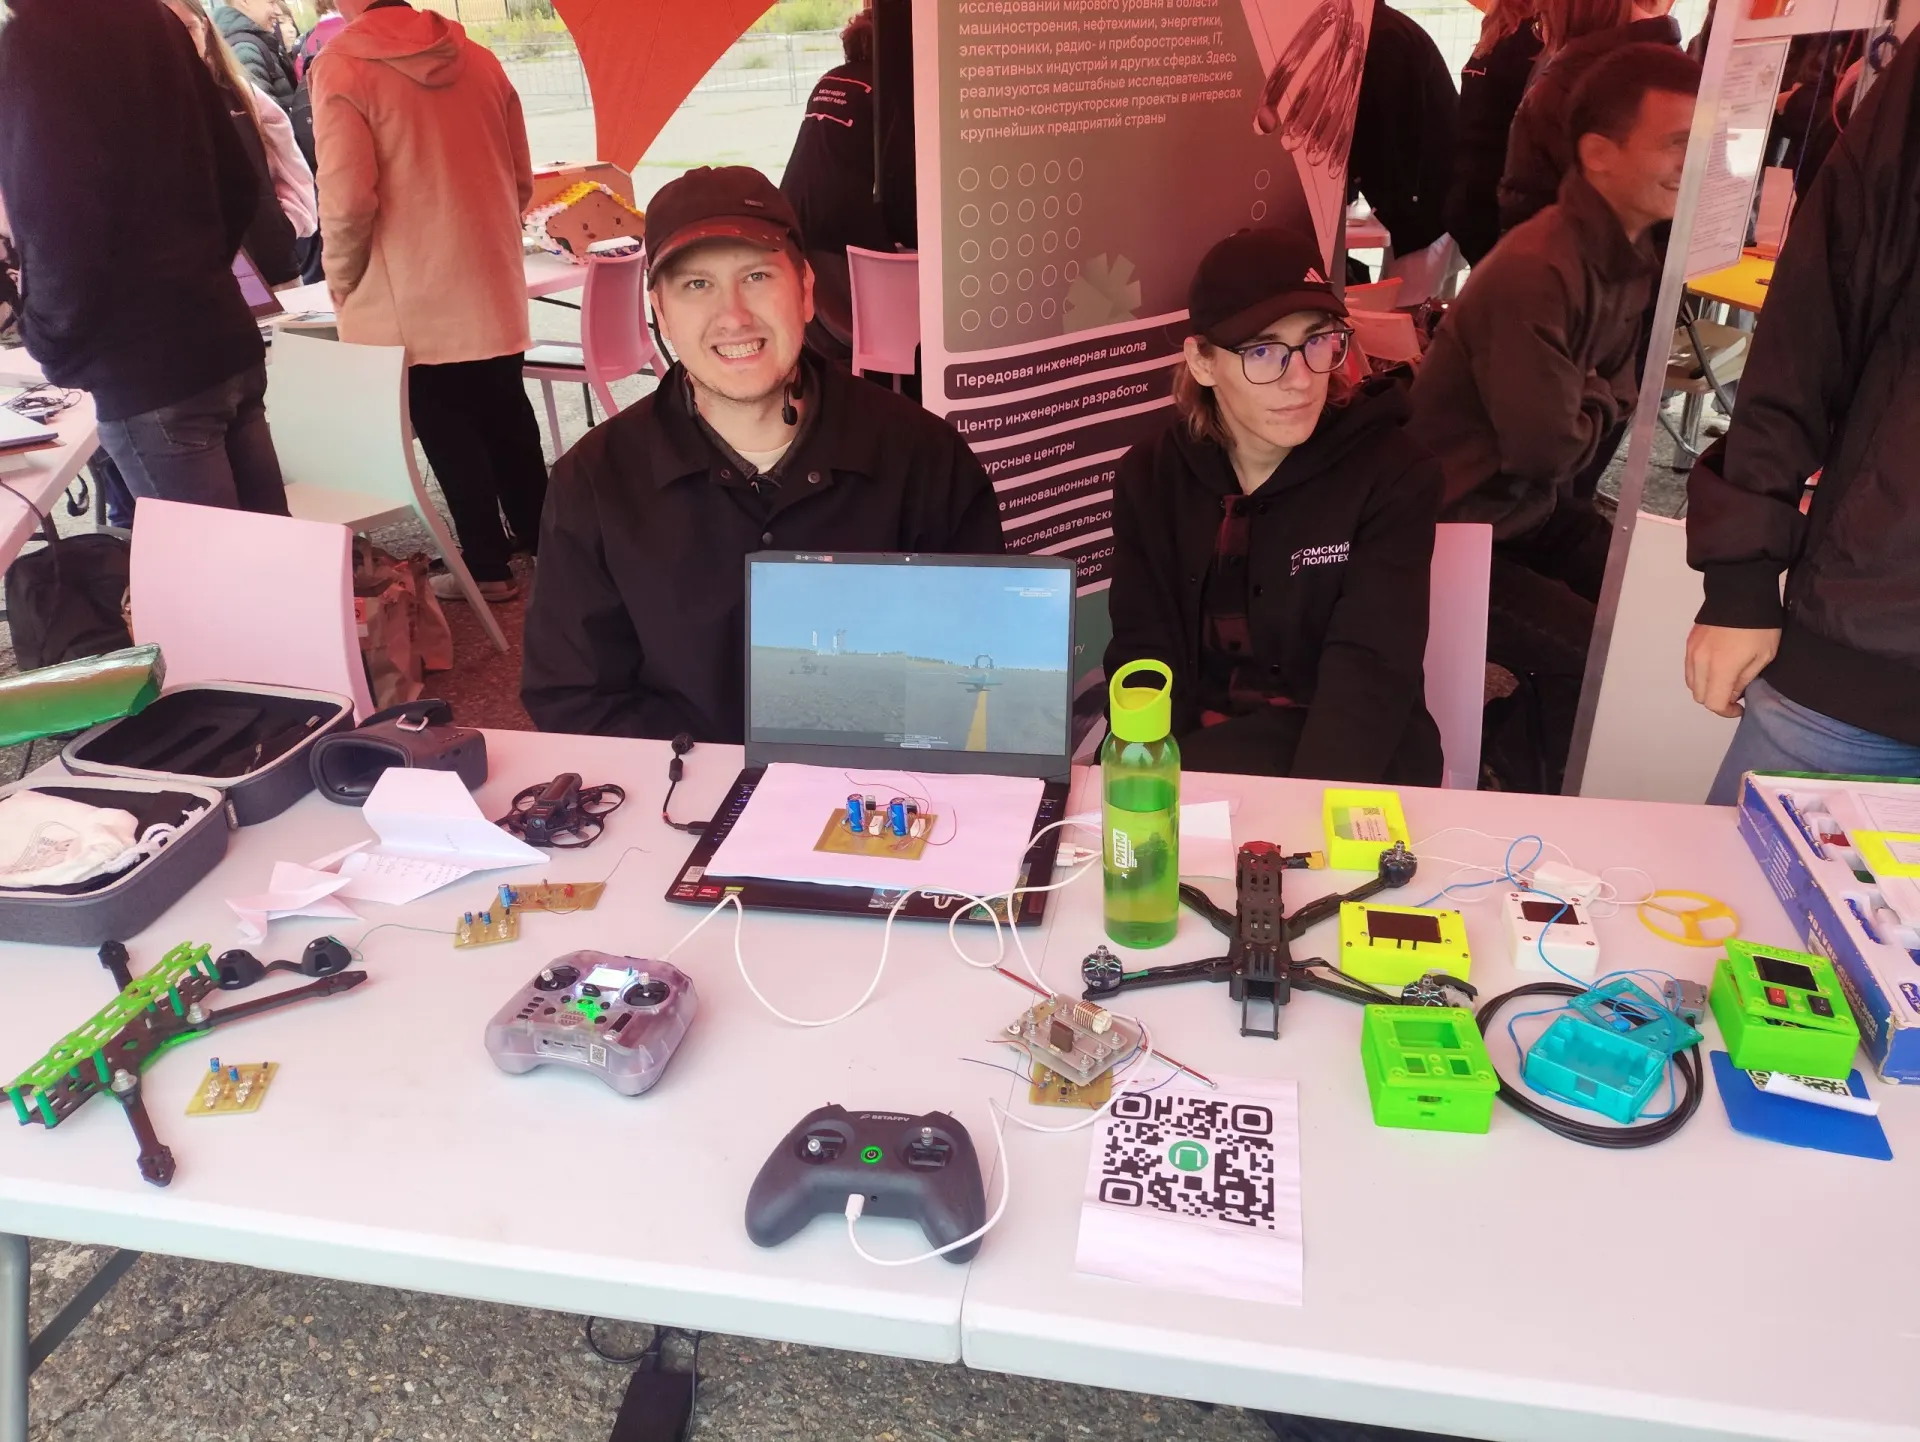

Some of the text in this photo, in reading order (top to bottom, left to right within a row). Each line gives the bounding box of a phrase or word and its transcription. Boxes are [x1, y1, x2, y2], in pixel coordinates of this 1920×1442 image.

[1063, 0, 1120, 14] мирового
[1122, 0, 1163, 13] уровня
[1166, 0, 1174, 8] в
[1175, 0, 1219, 8] области
[959, 16, 1223, 36] машиностроения, нефтехимии, энергетики,
[959, 31, 1224, 59] электроники, радио- и приборостроения, IT,
[959, 50, 1237, 81] креативных индустрий и других сферах. Здесь
[959, 70, 1233, 102] реализуются масштабные исследовательские
[960, 88, 1243, 119] и опытно-конструкторские проекты в интересах
[960, 113, 1167, 143] крупнейших предприятий страны
[956, 340, 1147, 389] Передовая инженерная школа
[957, 382, 1149, 435] Центр инженерных разработок
[981, 440, 1076, 475] урсные центры
[1009, 474, 1100, 508] инновационные
[1302, 540, 1350, 557] ОМСКИЙ
[1302, 553, 1350, 566] ПОЛИТЕХ
[1115, 832, 1127, 866] РИТМ
